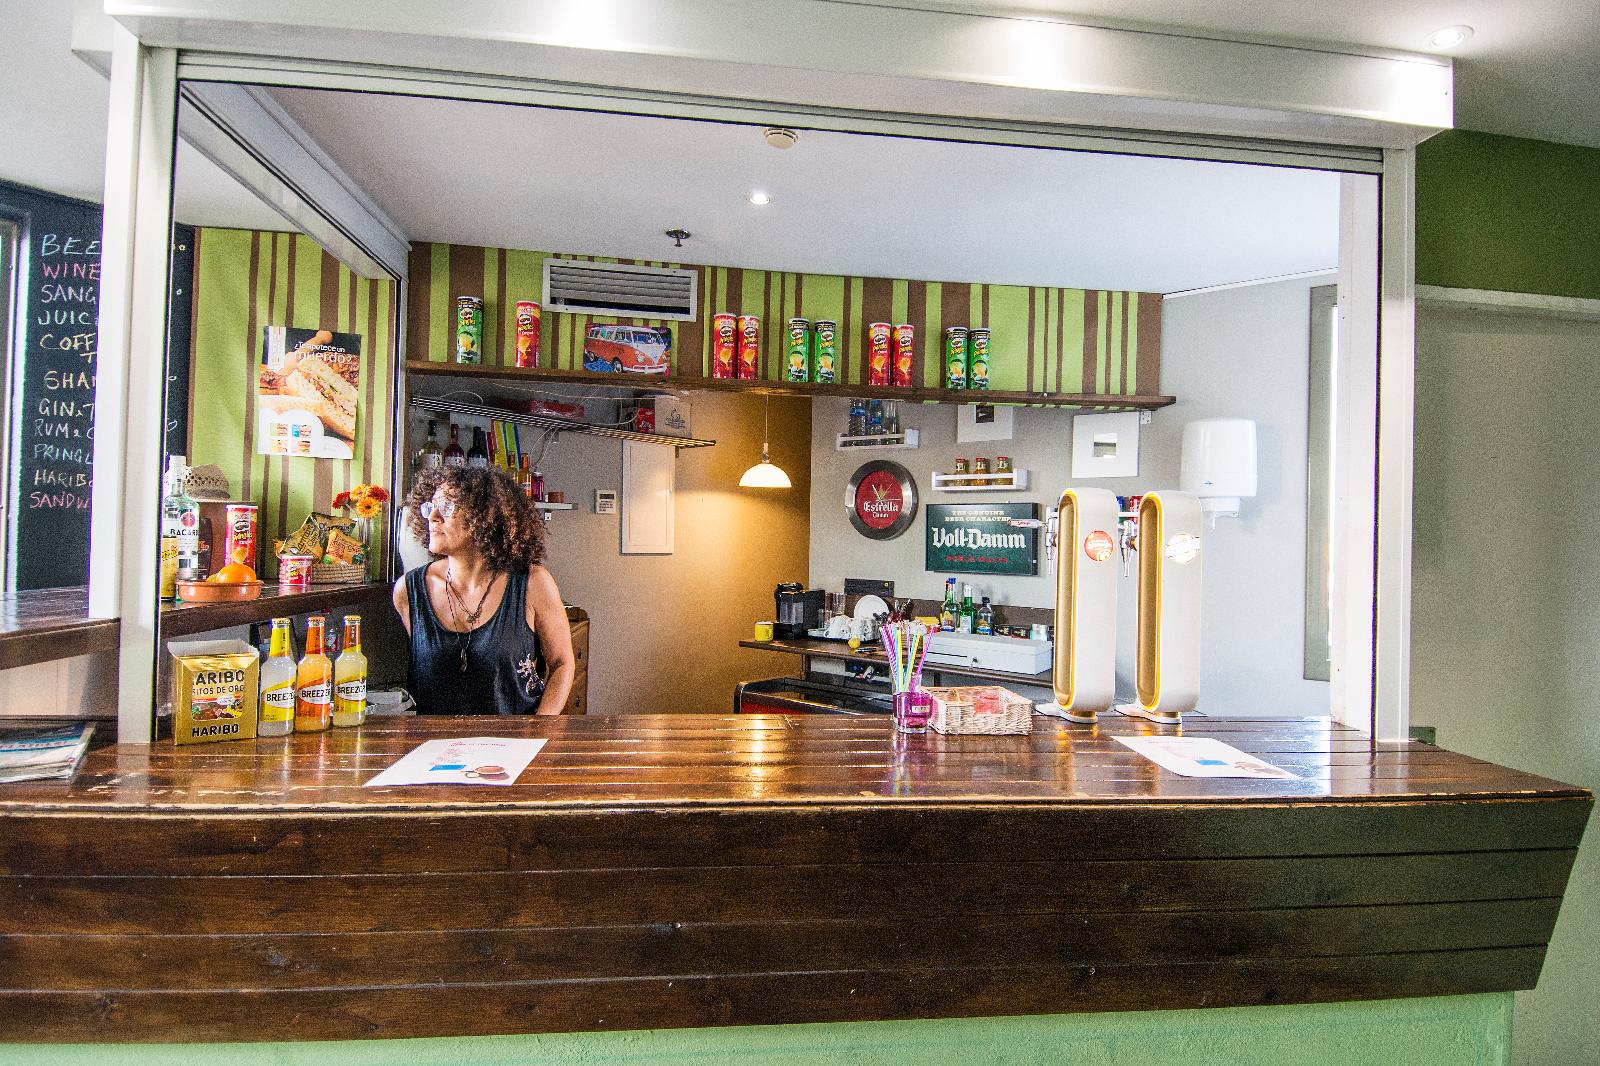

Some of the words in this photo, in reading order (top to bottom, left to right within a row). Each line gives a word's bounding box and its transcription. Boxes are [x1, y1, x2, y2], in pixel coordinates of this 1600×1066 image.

[38, 398, 75, 417] GIN
[34, 418, 69, 439] RUM
[931, 526, 1027, 550] Voll-Damm
[193, 669, 245, 685] ARIBO
[191, 723, 240, 737] HARIBO
